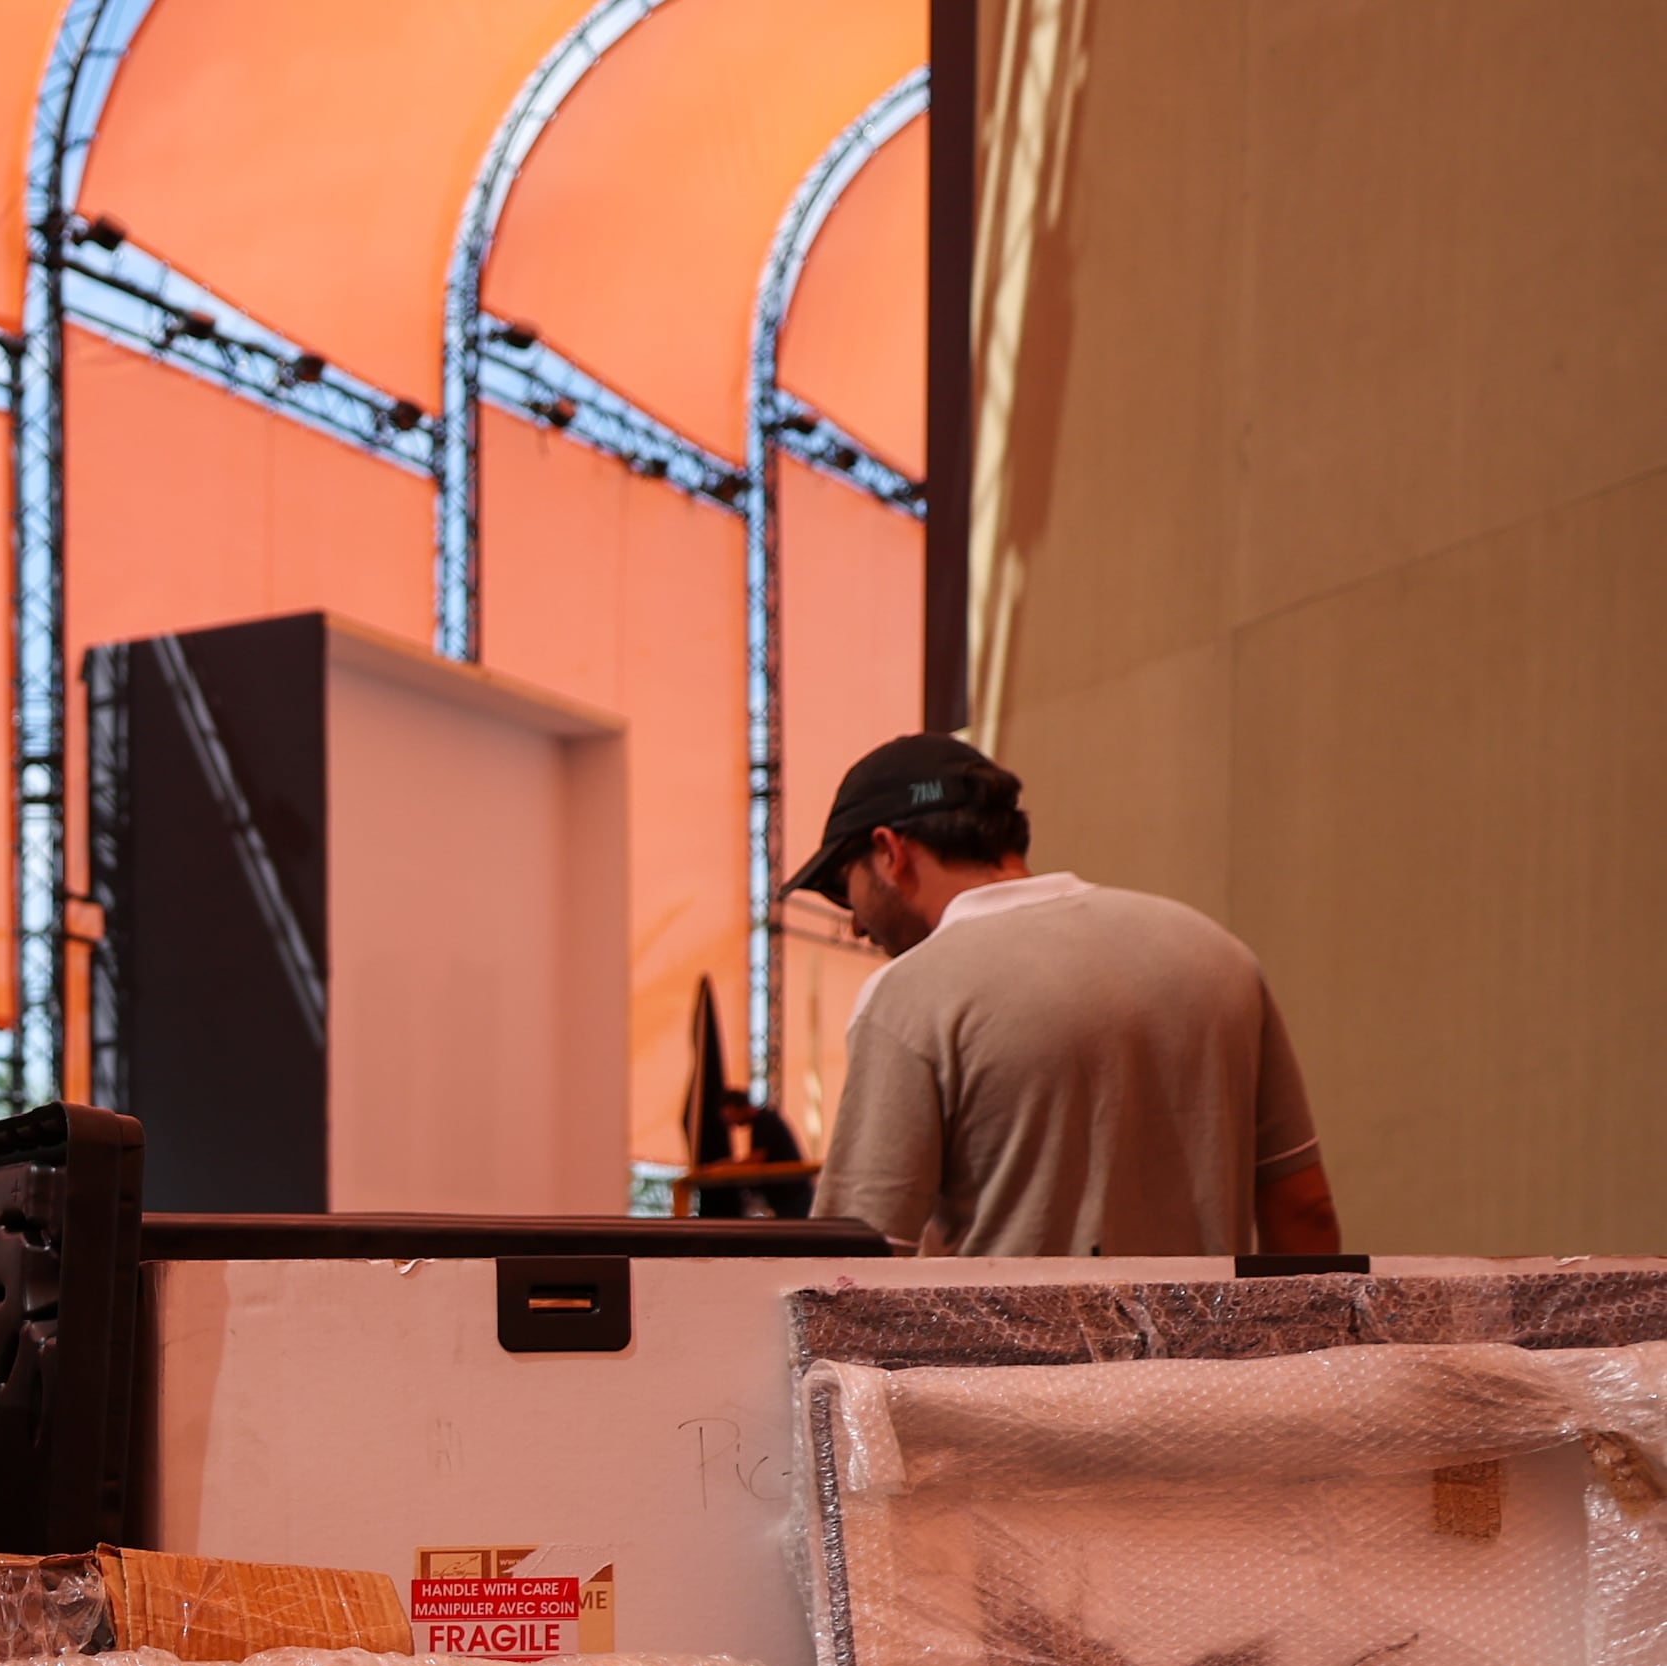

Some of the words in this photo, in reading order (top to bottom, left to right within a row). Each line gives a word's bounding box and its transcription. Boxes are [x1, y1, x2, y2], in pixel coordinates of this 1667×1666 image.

[677, 1417, 793, 1510] Pic
[422, 1582, 479, 1597] HANDLE
[483, 1582, 517, 1596] WITH
[521, 1581, 560, 1596] CARE
[415, 1602, 494, 1617] MANIPULER
[497, 1601, 536, 1616] AVEC
[540, 1600, 575, 1615] SOIN
[429, 1623, 560, 1653] FRAGILE
